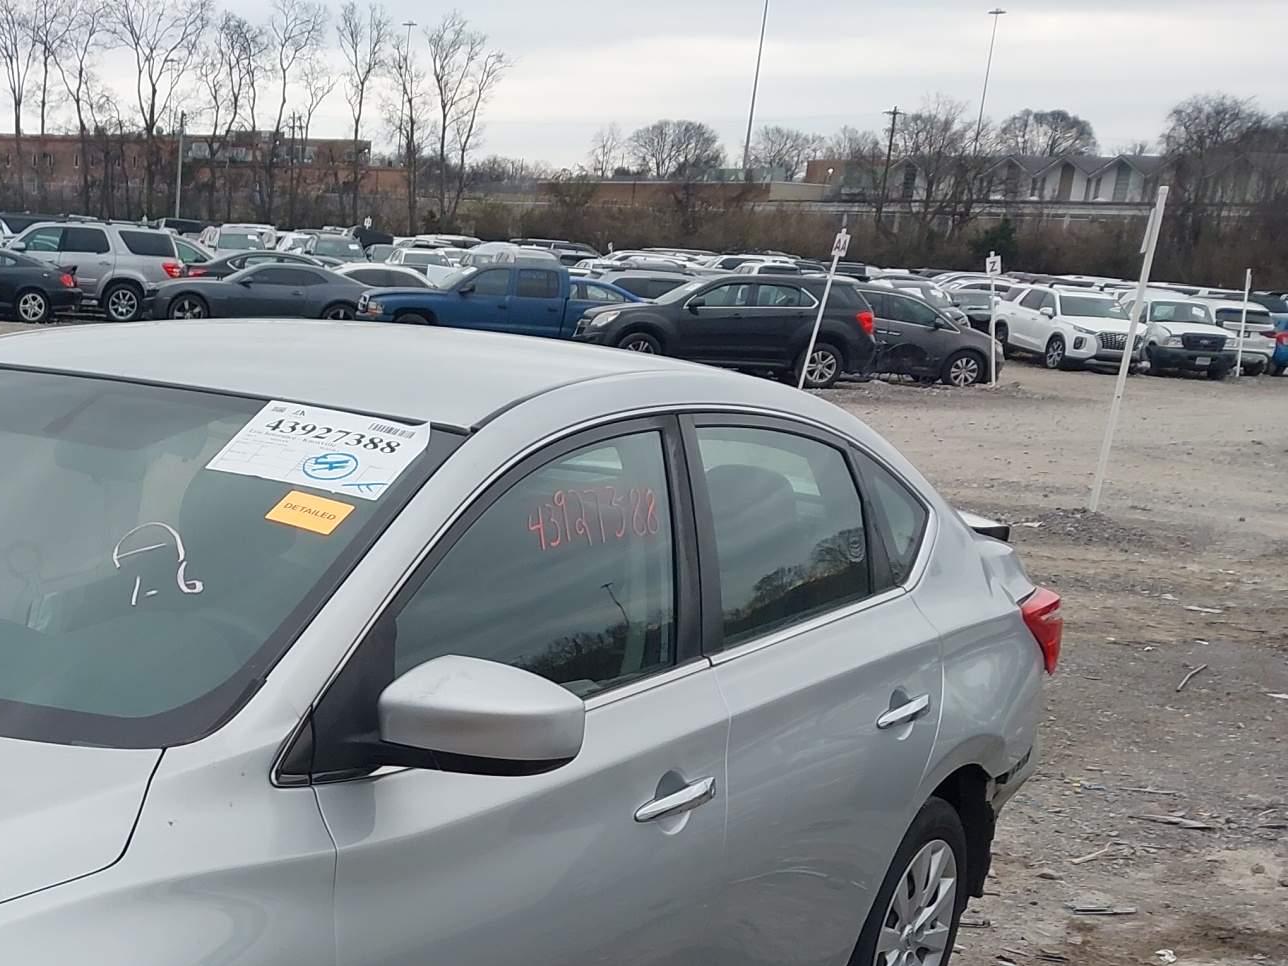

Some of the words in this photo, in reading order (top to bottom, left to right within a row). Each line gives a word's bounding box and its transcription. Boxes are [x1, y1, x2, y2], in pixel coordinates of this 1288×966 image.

[989, 260, 999, 273] Z
[265, 417, 402, 454] 43927388
[283, 501, 337, 522] DETAILED
